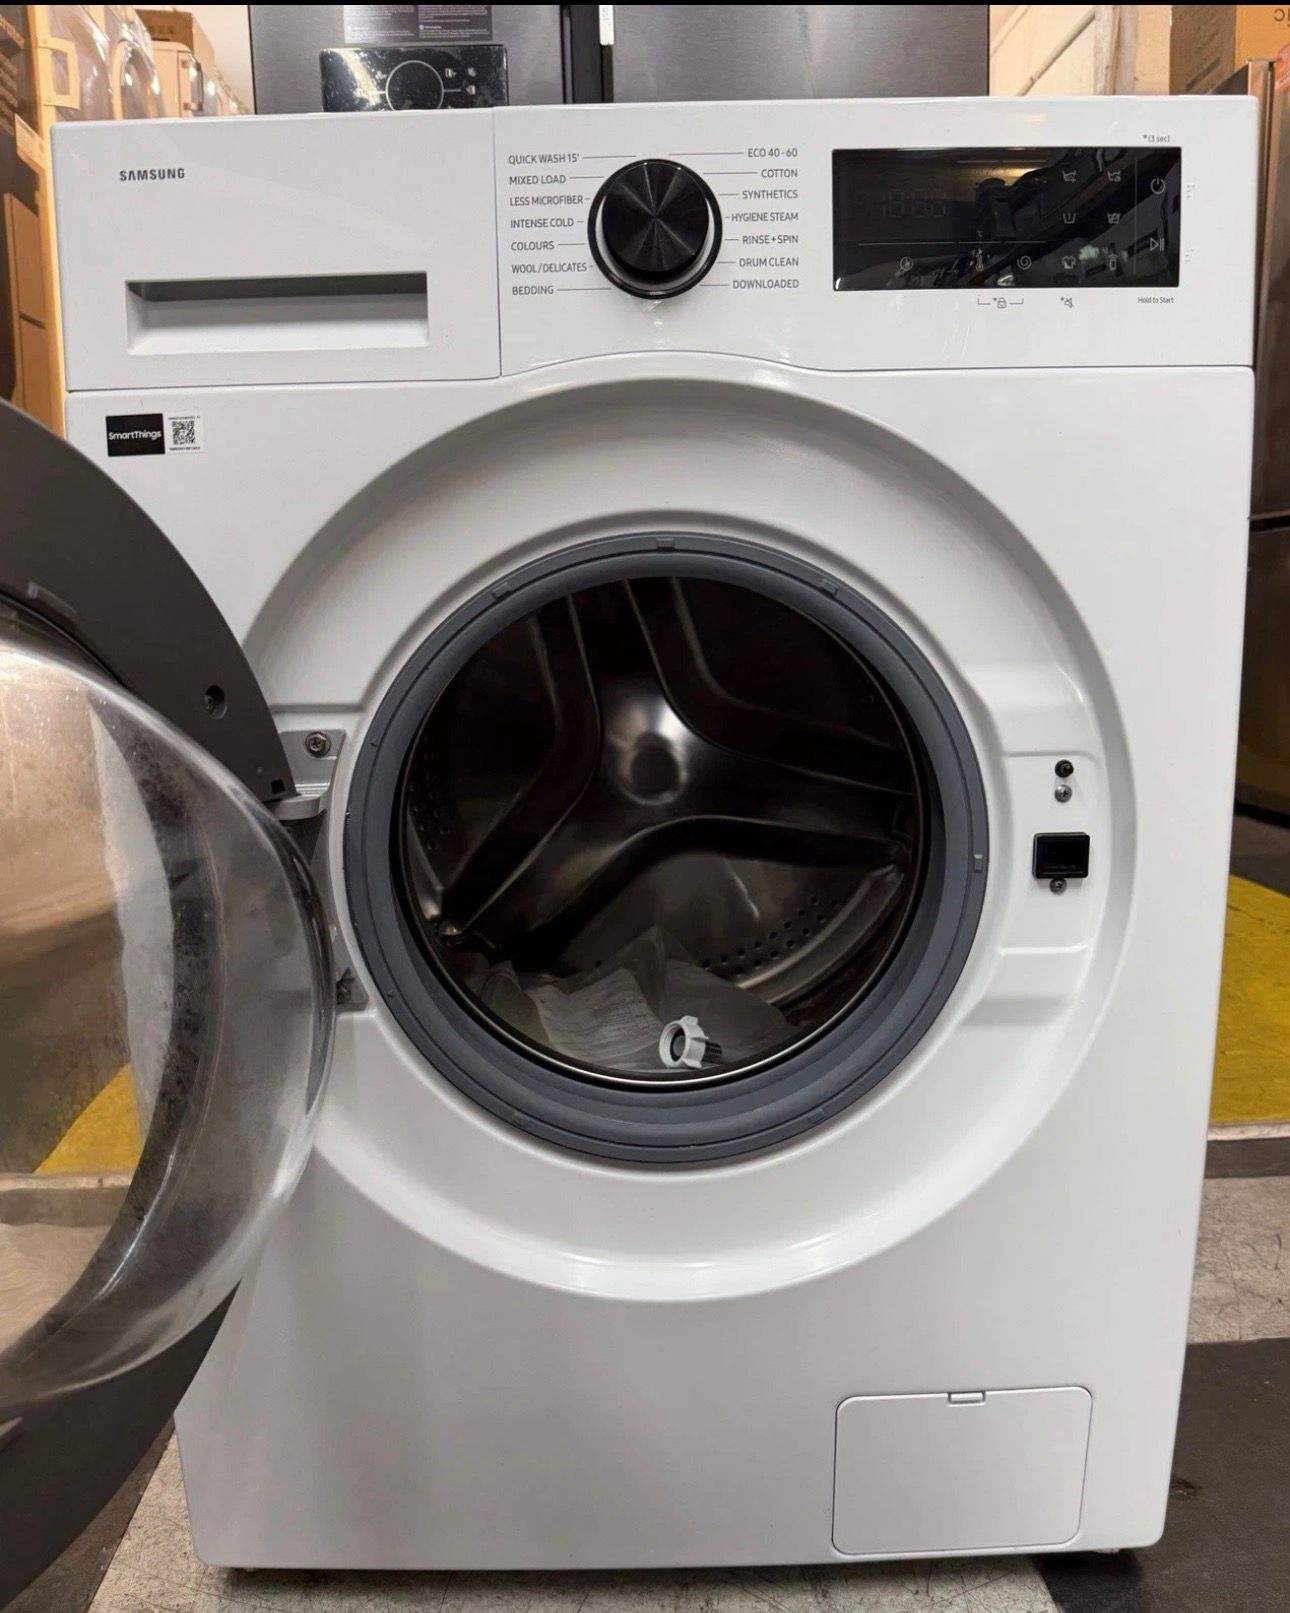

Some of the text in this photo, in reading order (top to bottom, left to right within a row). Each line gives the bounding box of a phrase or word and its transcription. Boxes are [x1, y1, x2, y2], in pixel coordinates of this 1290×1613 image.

[747, 147, 766, 158] ECO
[508, 154, 537, 166] QUICK
[538, 153, 565, 164] WASH
[119, 167, 185, 182] SAMSUNG
[761, 168, 798, 178] COTTON
[509, 174, 566, 185] MIXED LOAD
[510, 194, 583, 206] LESS MICROFIBER
[742, 189, 798, 200] SYNTHETICS
[731, 211, 799, 222] HYGIENE STEAM
[510, 217, 574, 229] INTENSE COLD
[511, 240, 555, 251] COLOURS
[739, 257, 799, 268] DRUM CLEAN
[732, 279, 800, 289] DOWNLOADED
[512, 285, 554, 295] BEDDING
[1137, 296, 1174, 304] Hold to Start
[108, 429, 162, 441] SmartThings
